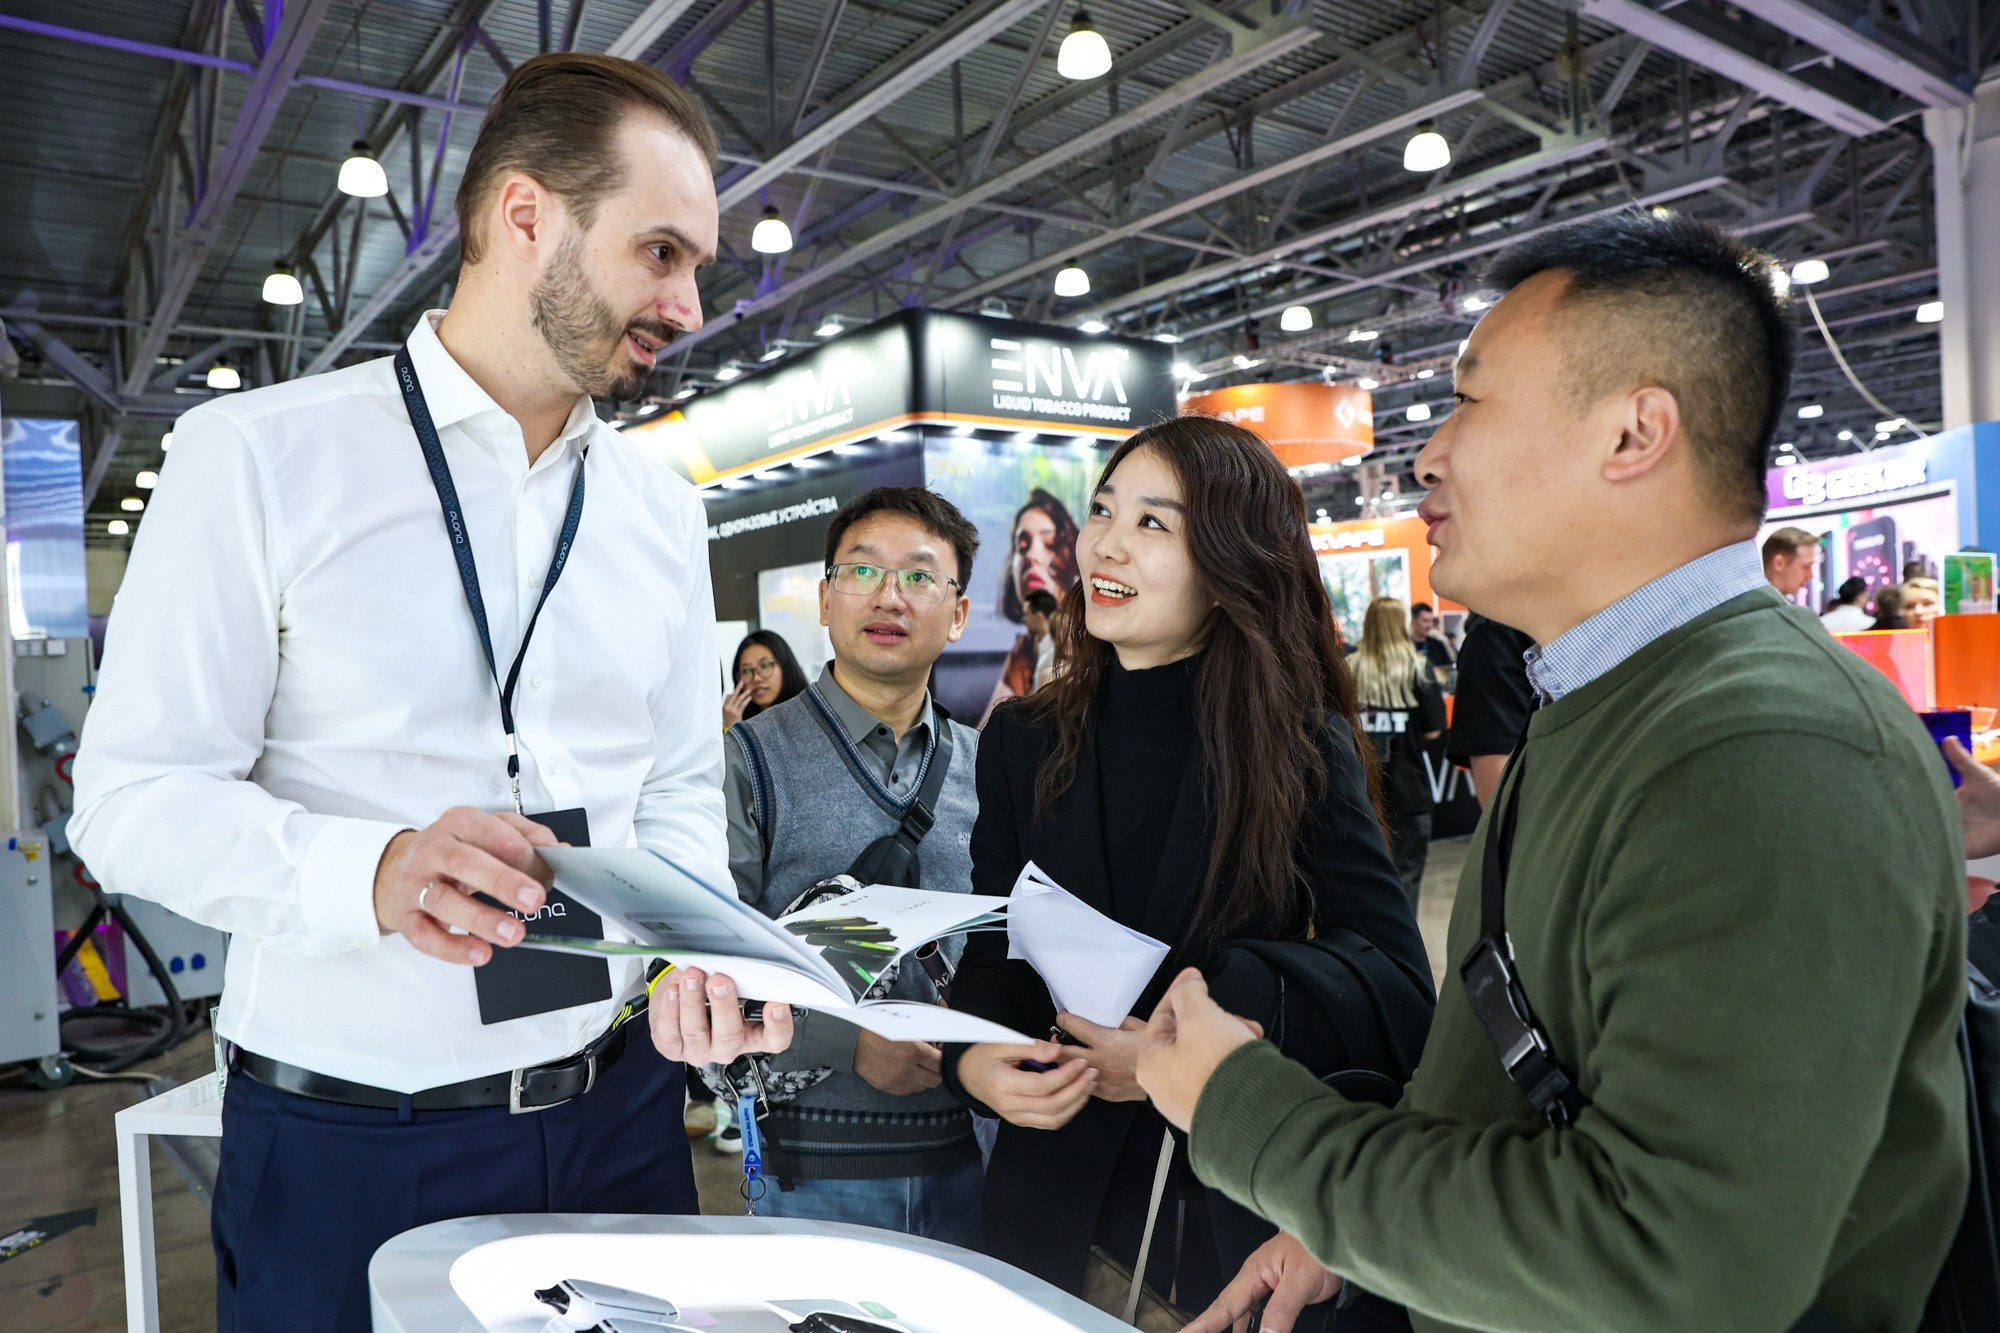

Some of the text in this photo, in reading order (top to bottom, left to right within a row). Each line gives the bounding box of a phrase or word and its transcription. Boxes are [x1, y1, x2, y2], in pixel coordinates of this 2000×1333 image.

[993, 393, 1132, 422] LIQUID TOBACCO PRODUCT
[779, 496, 838, 524] УСТРОЙСТВА
